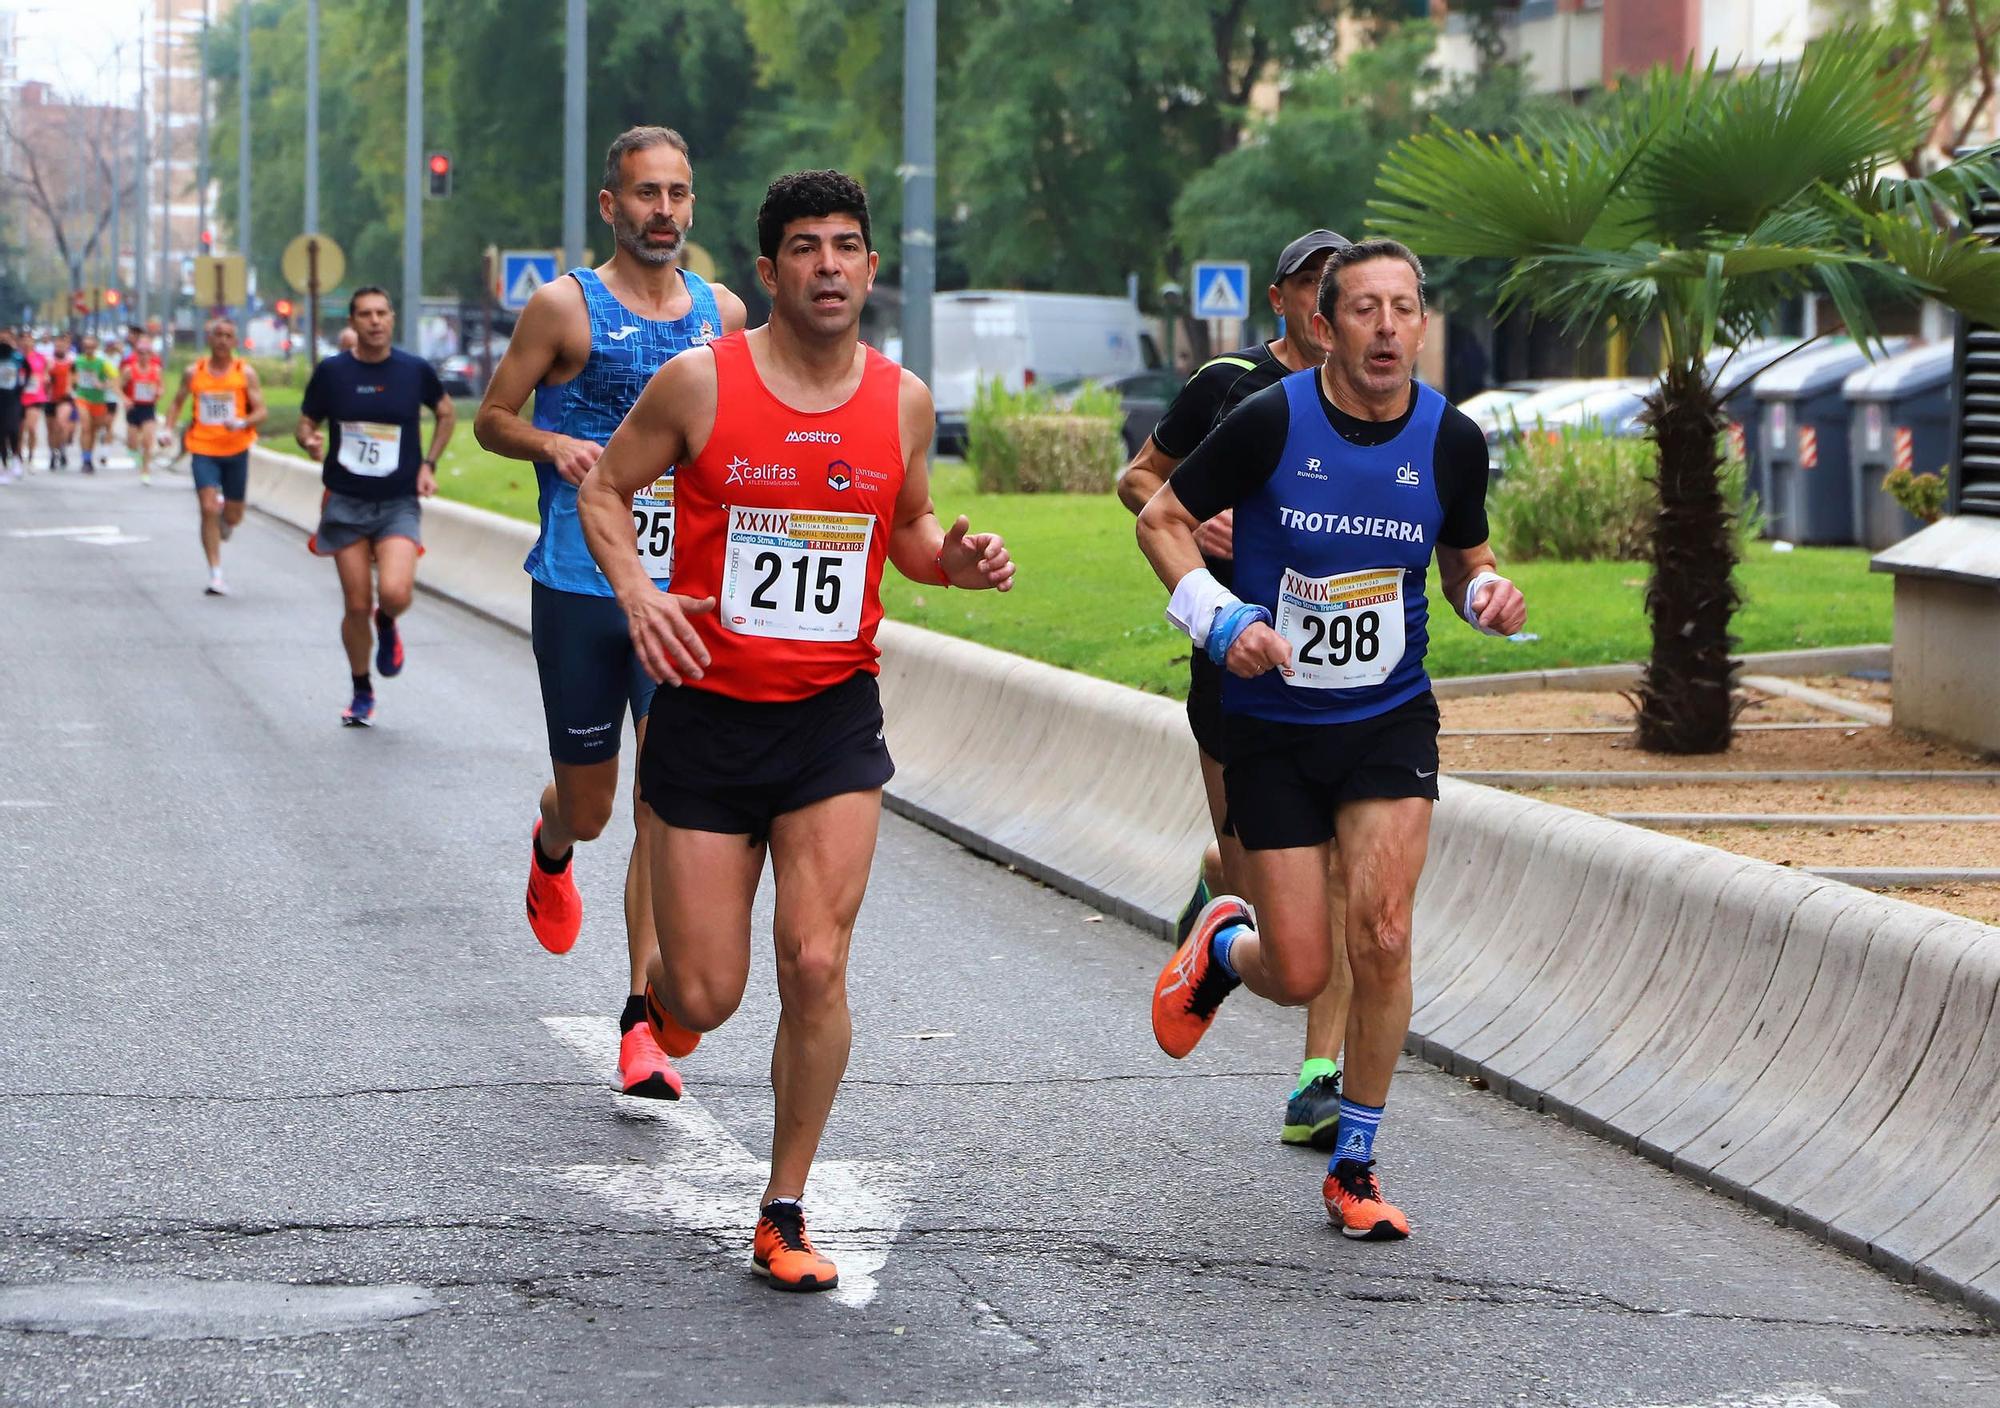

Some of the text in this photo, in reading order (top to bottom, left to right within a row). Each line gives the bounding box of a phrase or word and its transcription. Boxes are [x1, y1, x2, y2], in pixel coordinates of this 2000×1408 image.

[358, 440, 380, 464] 75
[743, 464, 796, 480] califas
[1297, 471, 1328, 481] RUNOPRO
[735, 511, 790, 535] XXXIX
[1280, 506, 1424, 543] TROTASIERRA
[732, 533, 756, 543] Colegio
[778, 538, 804, 548] Trinidad
[810, 541, 864, 551] TRINITARIOS
[750, 551, 843, 614] 215
[1286, 573, 1329, 601] XXXIX
[1320, 603, 1344, 611] Trinidad
[1348, 592, 1398, 608] TRINITARIOS
[1298, 610, 1380, 667] 298
